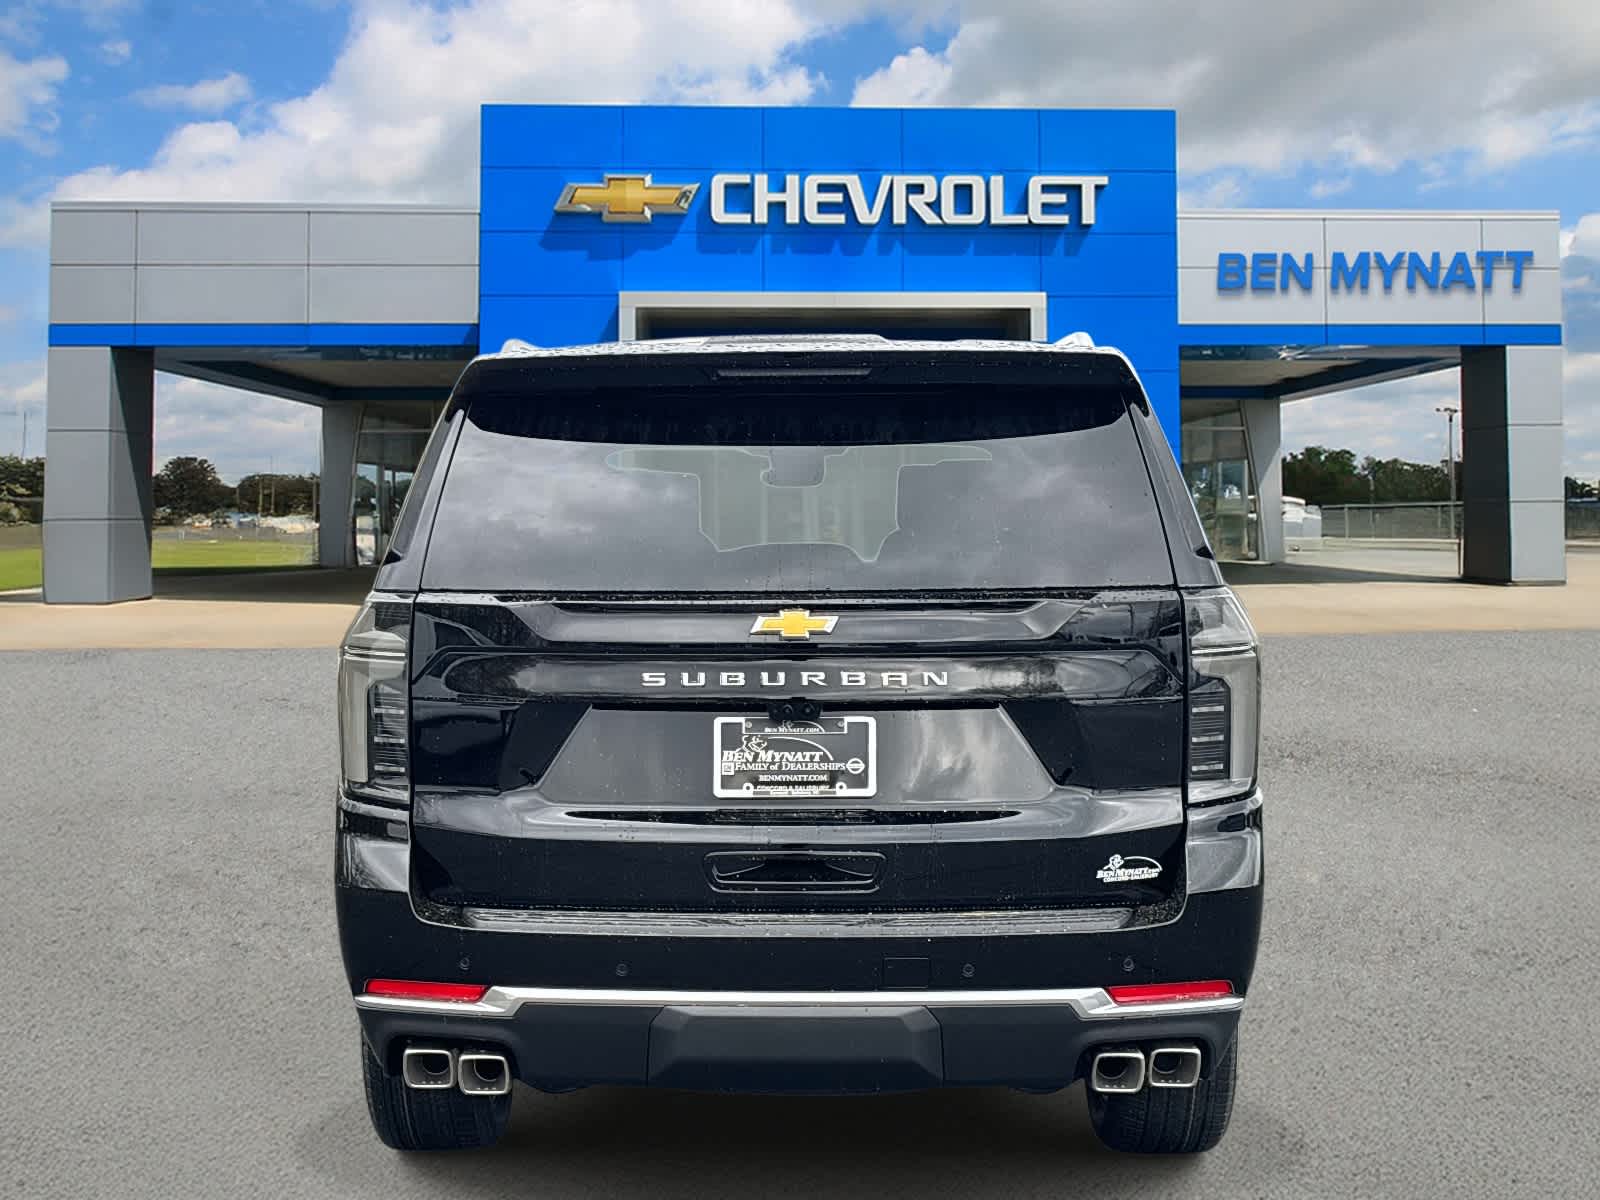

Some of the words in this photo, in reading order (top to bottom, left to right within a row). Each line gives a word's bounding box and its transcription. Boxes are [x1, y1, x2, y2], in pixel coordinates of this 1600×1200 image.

[710, 173, 1109, 226] CHEVROLET
[1217, 252, 1314, 291] BEN
[1330, 251, 1534, 291] MYNATT
[641, 671, 949, 687] SUBURBAN
[722, 751, 754, 762] BEN
[757, 750, 824, 762] MYNATT
[735, 763, 769, 771] FAMILY
[782, 762, 846, 771] DEALERSHIPS
